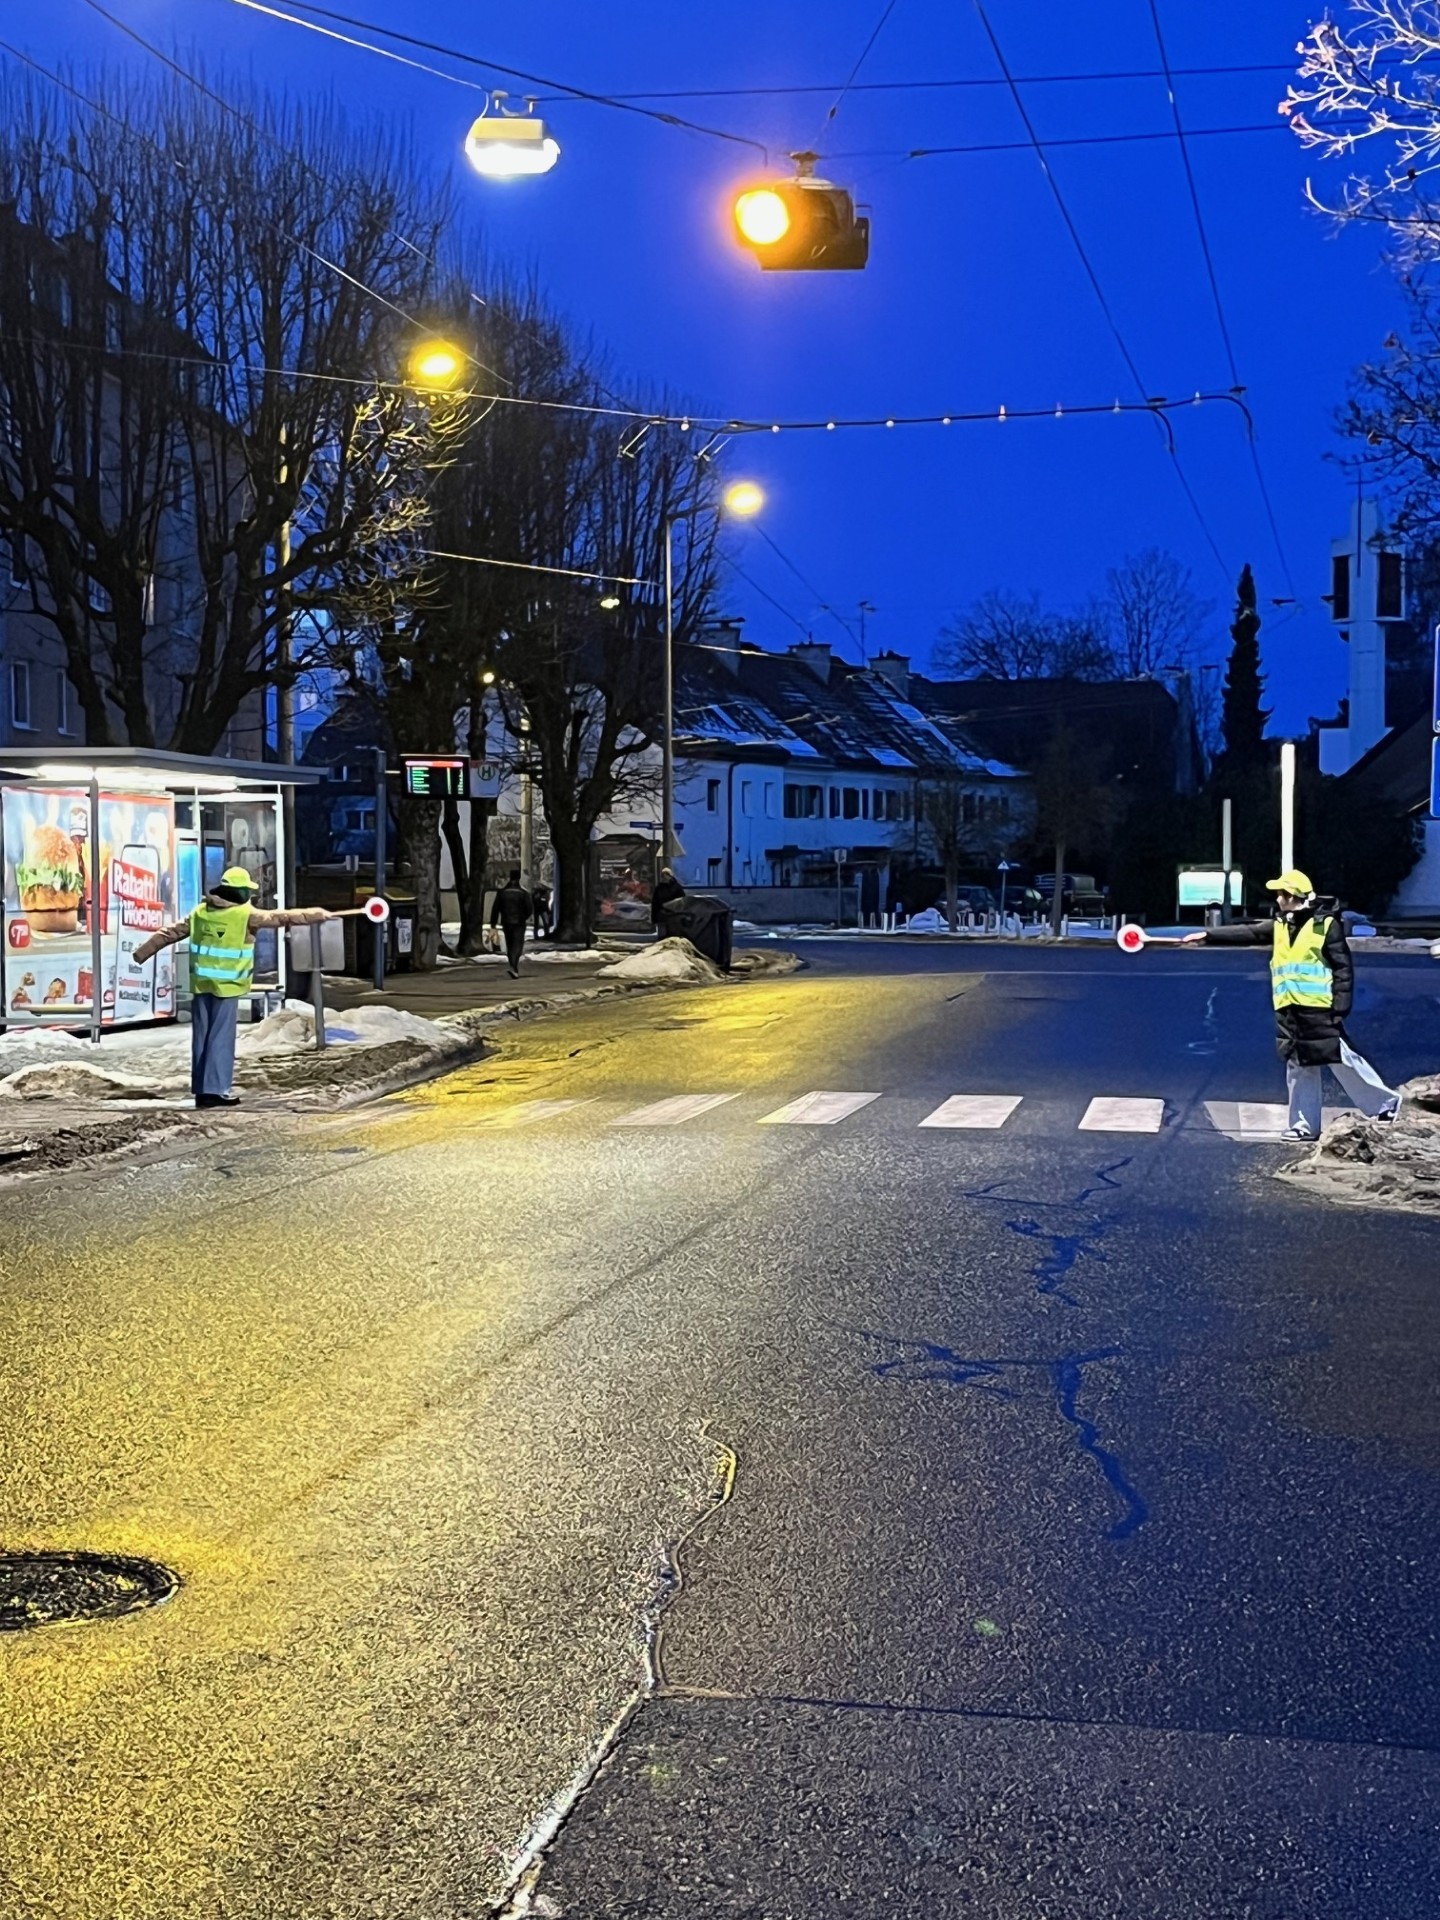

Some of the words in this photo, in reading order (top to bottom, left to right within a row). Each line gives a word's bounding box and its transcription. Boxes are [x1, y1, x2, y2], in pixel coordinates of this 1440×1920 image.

[481, 765, 491, 777] H
[114, 862, 155, 901] Rabatt
[123, 900, 163, 928] Wochen
